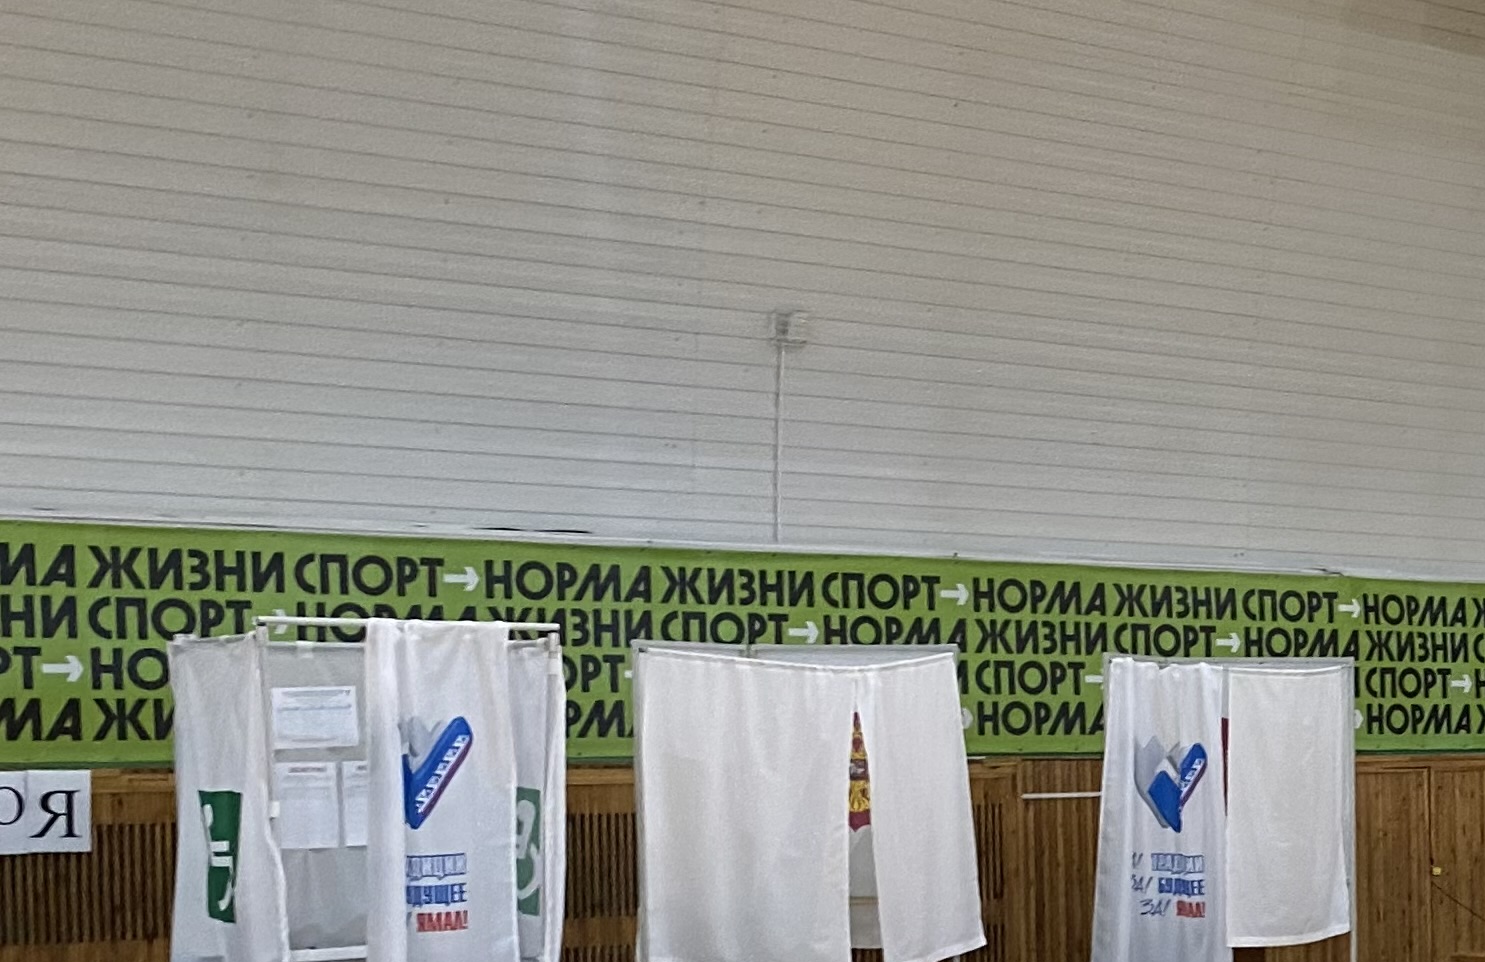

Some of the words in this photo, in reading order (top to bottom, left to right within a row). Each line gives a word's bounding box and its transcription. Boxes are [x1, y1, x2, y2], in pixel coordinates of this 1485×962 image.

[87, 545, 285, 593] ЖИЗНИ
[294, 553, 444, 598] СПОРТ
[484, 560, 652, 603] НОРМА
[660, 566, 815, 608] ЖИЗНИ
[822, 572, 941, 611] СПОРТ
[972, 577, 1106, 616] НОРМА
[1112, 583, 1237, 620] ЖИЗНИ
[1242, 589, 1339, 623] СПОРТ
[1362, 593, 1467, 627] НОРМА
[88, 596, 252, 641] СПОРТ
[661, 611, 789, 645] СПОРТ
[823, 615, 967, 653] НОРМА
[975, 619, 1108, 656] ЖИЗНИ
[1114, 623, 1216, 657] СПОРТ
[1243, 627, 1360, 661] НОРМА
[1365, 630, 1468, 663] ЖИЗНИ
[975, 660, 1086, 695] СПОРТ
[1365, 667, 1452, 699] СПОРТ
[1366, 703, 1471, 735] НОРМА
